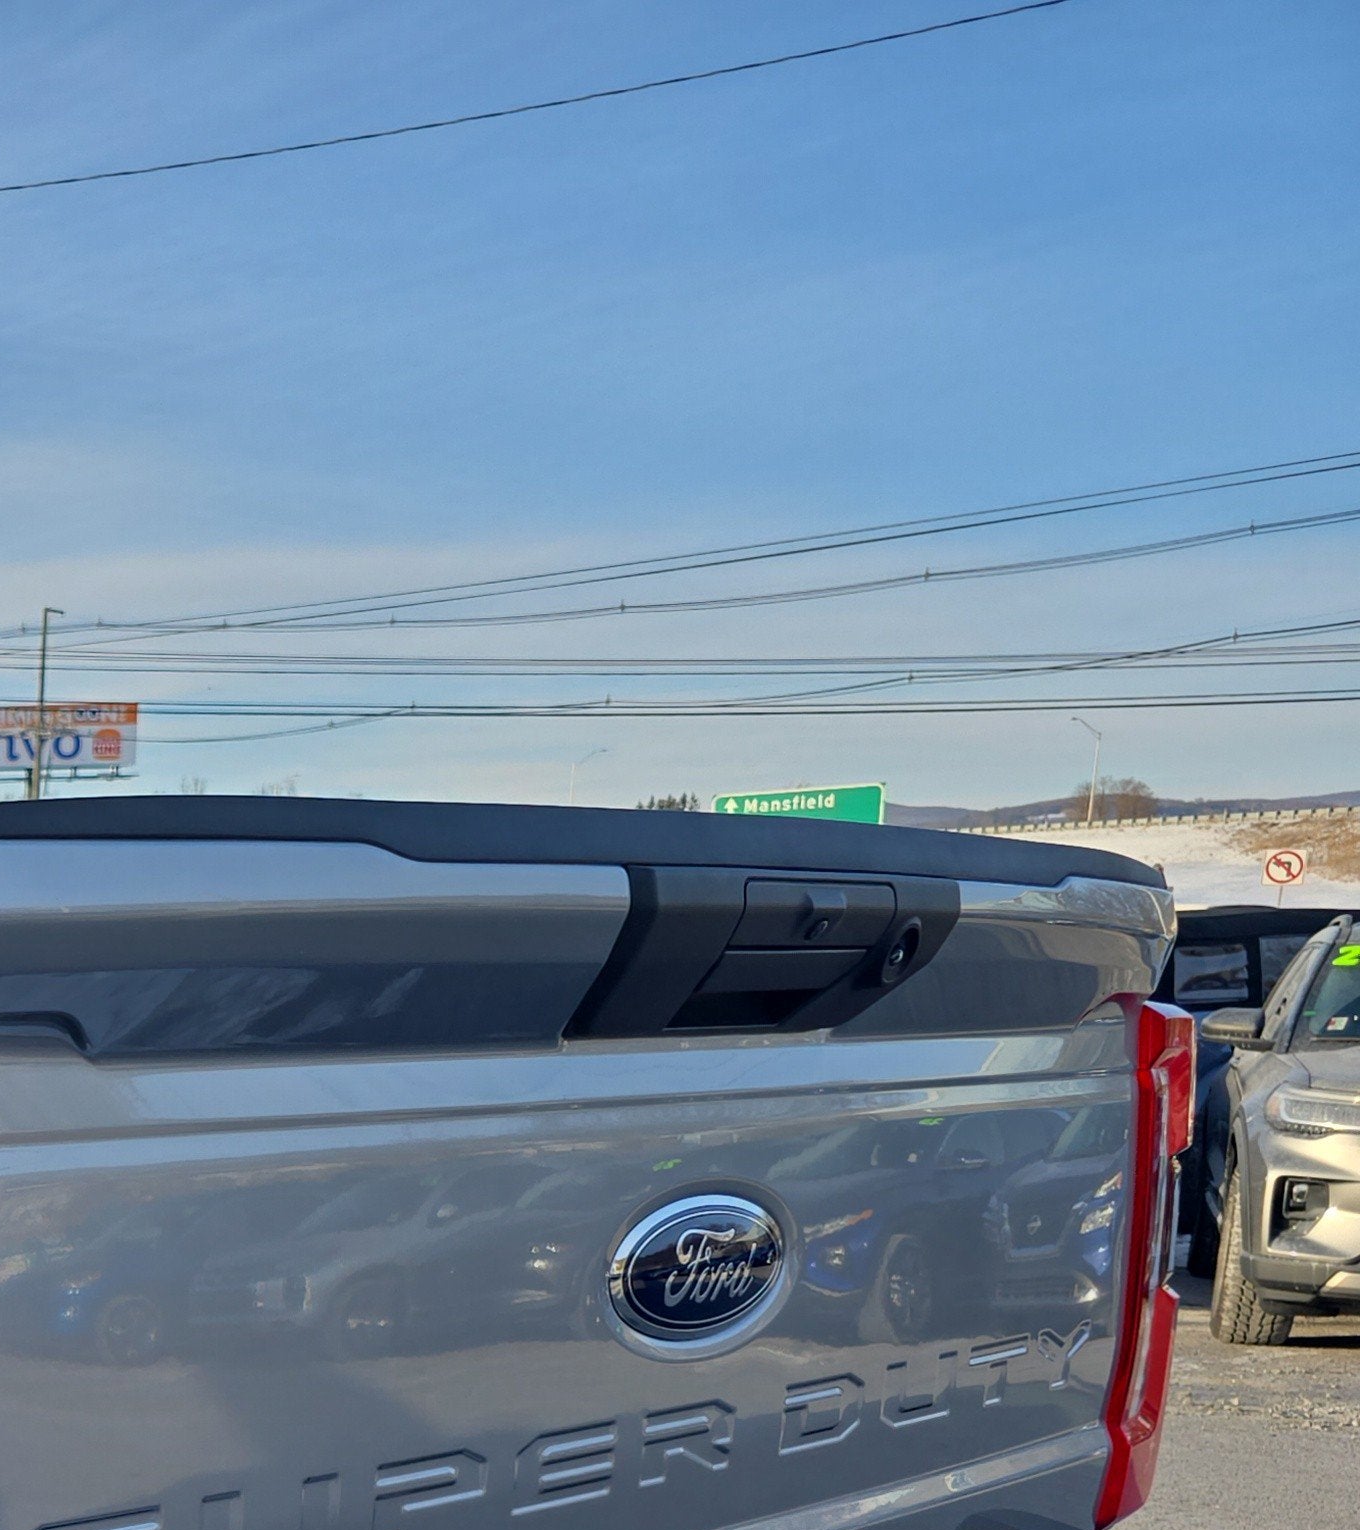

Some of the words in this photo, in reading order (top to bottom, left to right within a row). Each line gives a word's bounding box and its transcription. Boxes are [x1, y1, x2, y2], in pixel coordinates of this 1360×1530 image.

[743, 793, 836, 813] Mansfield
[663, 1227, 758, 1308] Ford
[777, 1317, 1093, 1457] DUTY
